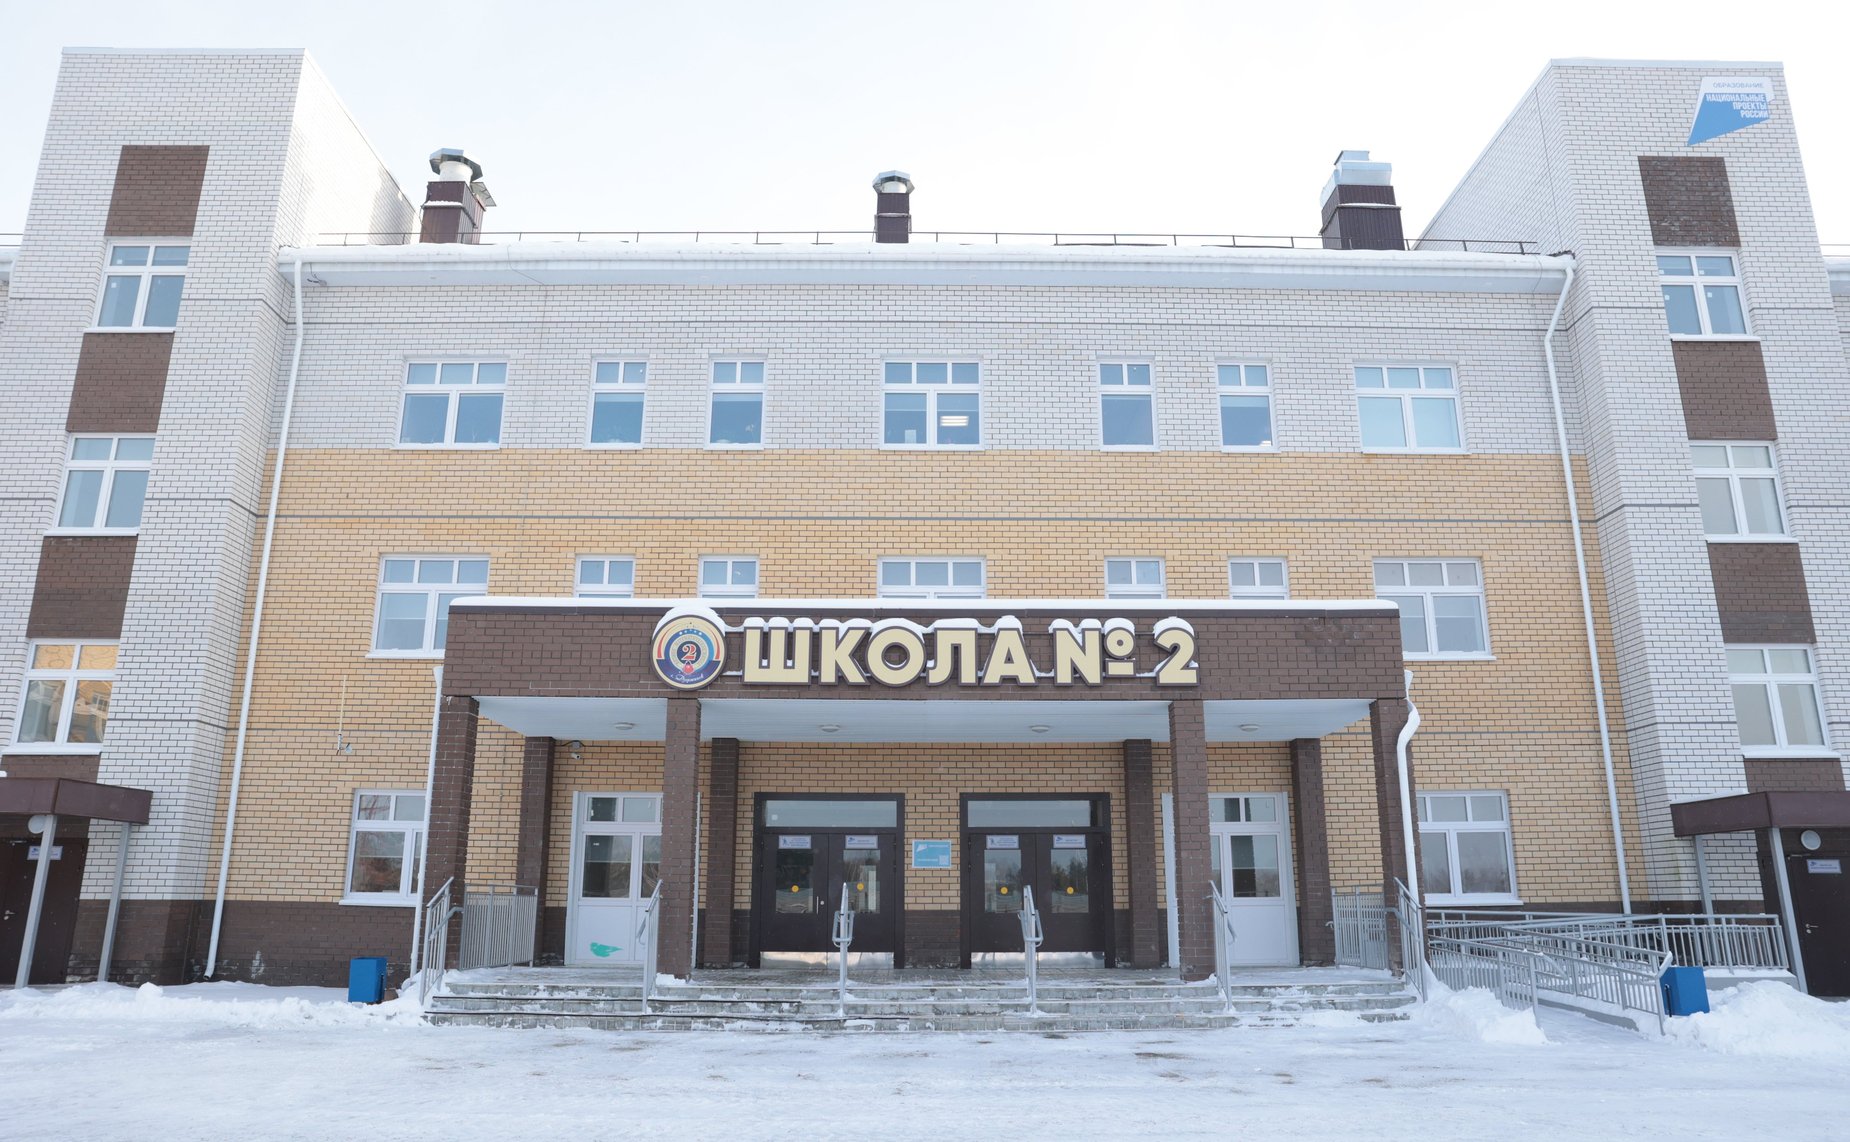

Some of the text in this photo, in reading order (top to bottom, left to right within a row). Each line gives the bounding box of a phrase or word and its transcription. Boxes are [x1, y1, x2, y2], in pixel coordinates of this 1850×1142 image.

[1706, 94, 1766, 102] НАЦИОНАЛЬНЫЕ
[1733, 102, 1767, 110] ПРОЕКТЫ
[1741, 110, 1769, 118] РОССИИ
[681, 643, 697, 661] 2
[742, 625, 1039, 687] ШКОЛА
[1153, 626, 1199, 687] 2
